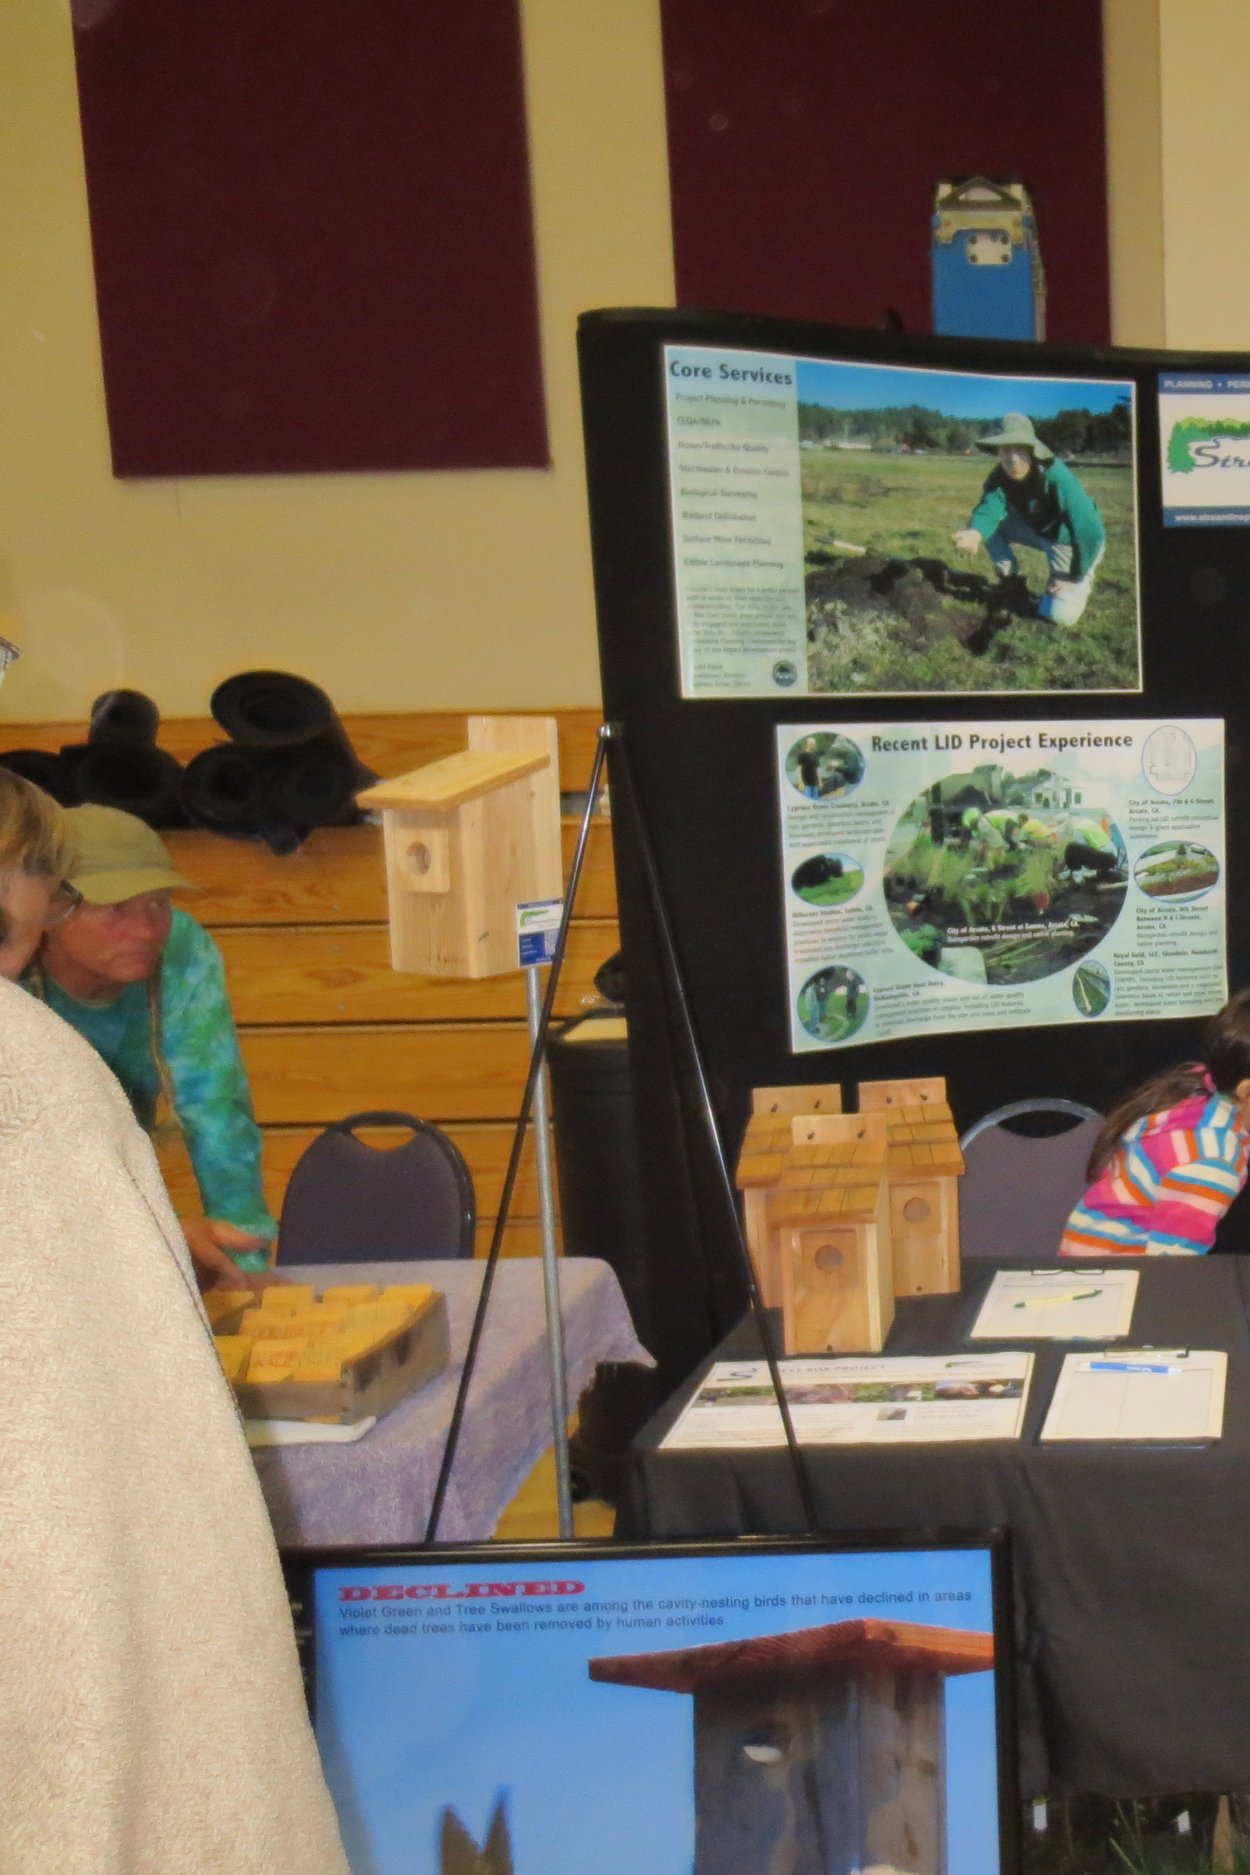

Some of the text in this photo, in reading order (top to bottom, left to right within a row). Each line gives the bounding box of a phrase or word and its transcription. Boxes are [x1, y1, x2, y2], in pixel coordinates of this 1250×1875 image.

[670, 360, 793, 385] Core Services
[1164, 381, 1213, 389] PLANNING
[871, 732, 1133, 753] Recent LID Project Experience
[339, 1580, 586, 1601] DECLINED
[339, 1590, 972, 1620] Violet Green and Tree Swallows are among the cavity-nesting birds that have declined in areas
[339, 1613, 727, 1637] where dead trees have been removed by human activities.
